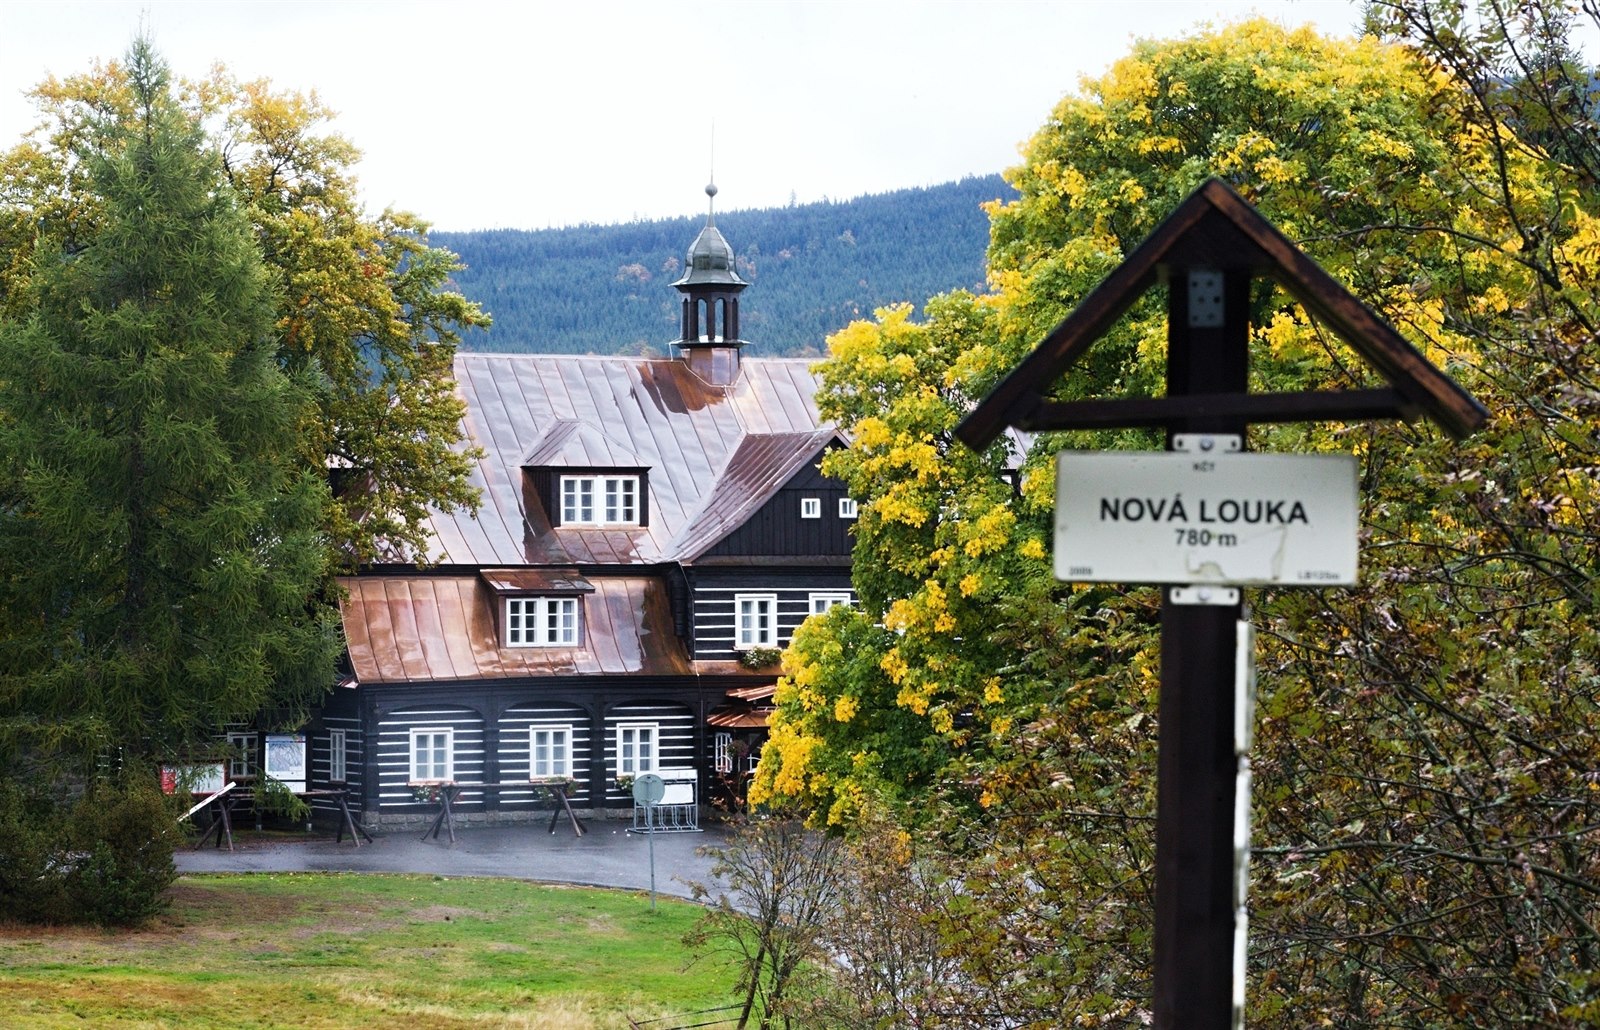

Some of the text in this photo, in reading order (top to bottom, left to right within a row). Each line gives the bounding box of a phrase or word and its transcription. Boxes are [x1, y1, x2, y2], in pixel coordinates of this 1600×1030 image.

[1101, 494, 1308, 524] NOVÁ LOUKA
[1175, 529, 1238, 546] 780 m
